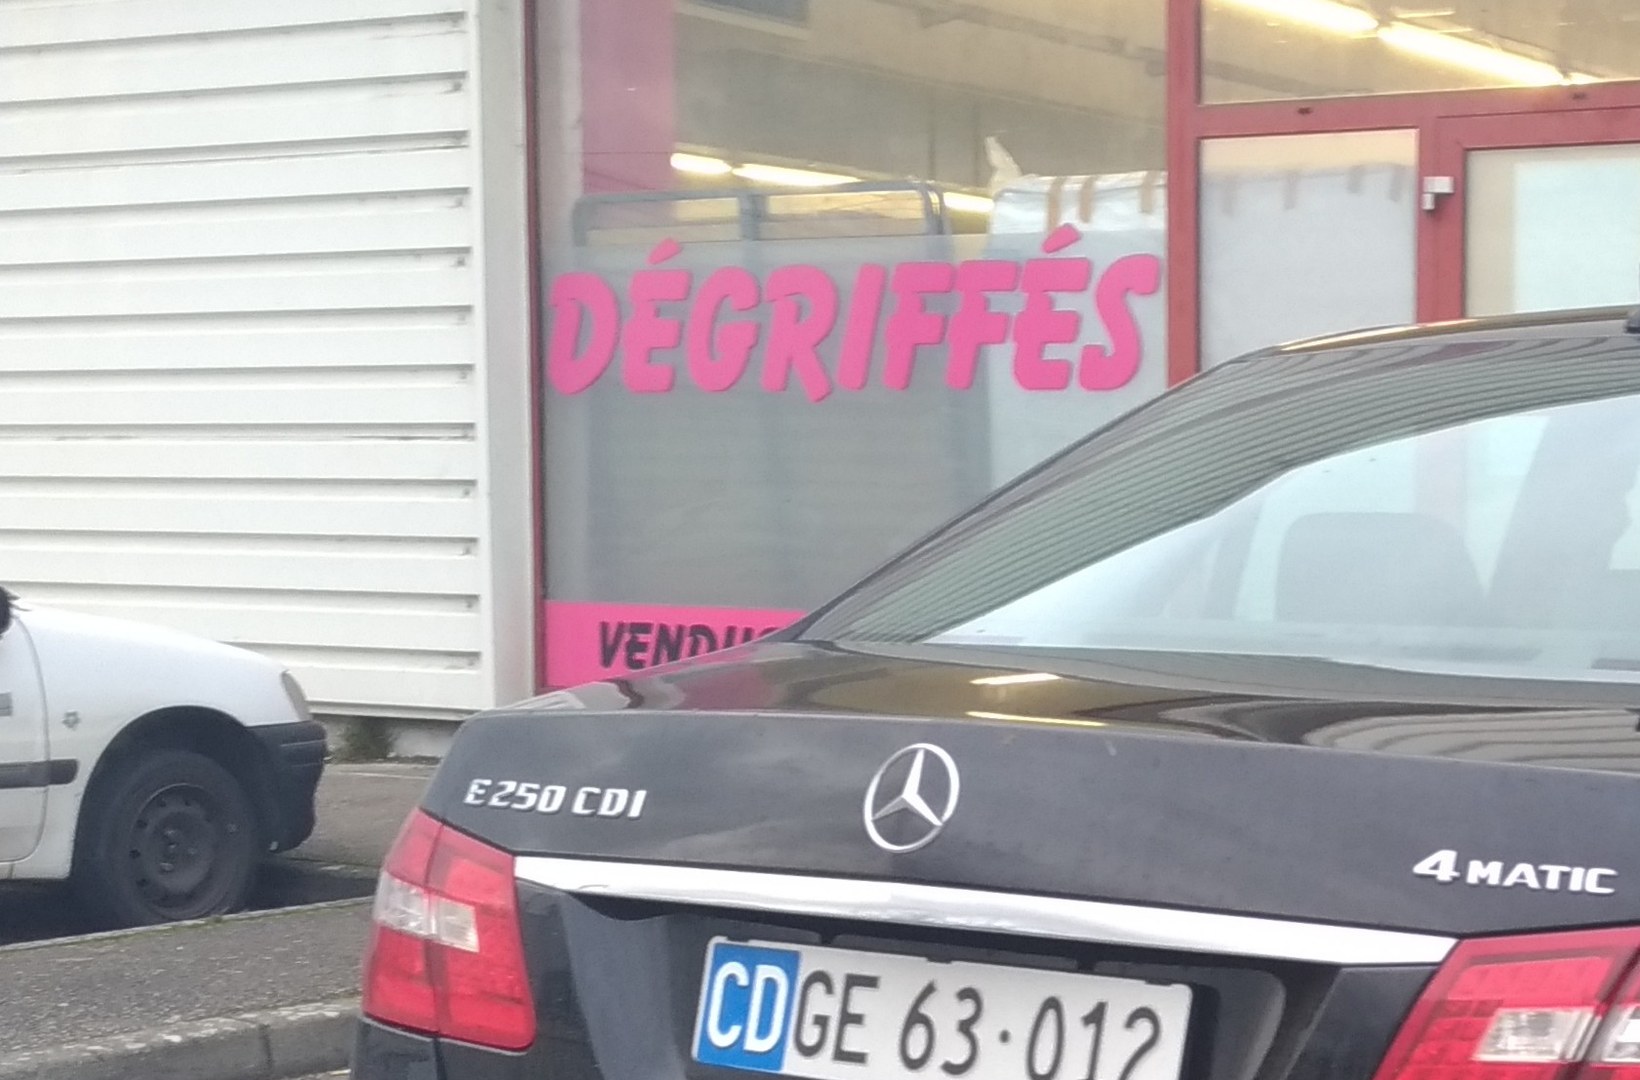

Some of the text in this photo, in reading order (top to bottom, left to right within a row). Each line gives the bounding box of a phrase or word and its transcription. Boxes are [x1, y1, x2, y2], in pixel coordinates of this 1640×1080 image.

[546, 223, 1161, 402] DÉGRIFFÉS
[571, 786, 648, 819] CDI
[706, 960, 790, 1054] CD
[793, 969, 882, 1065] GE
